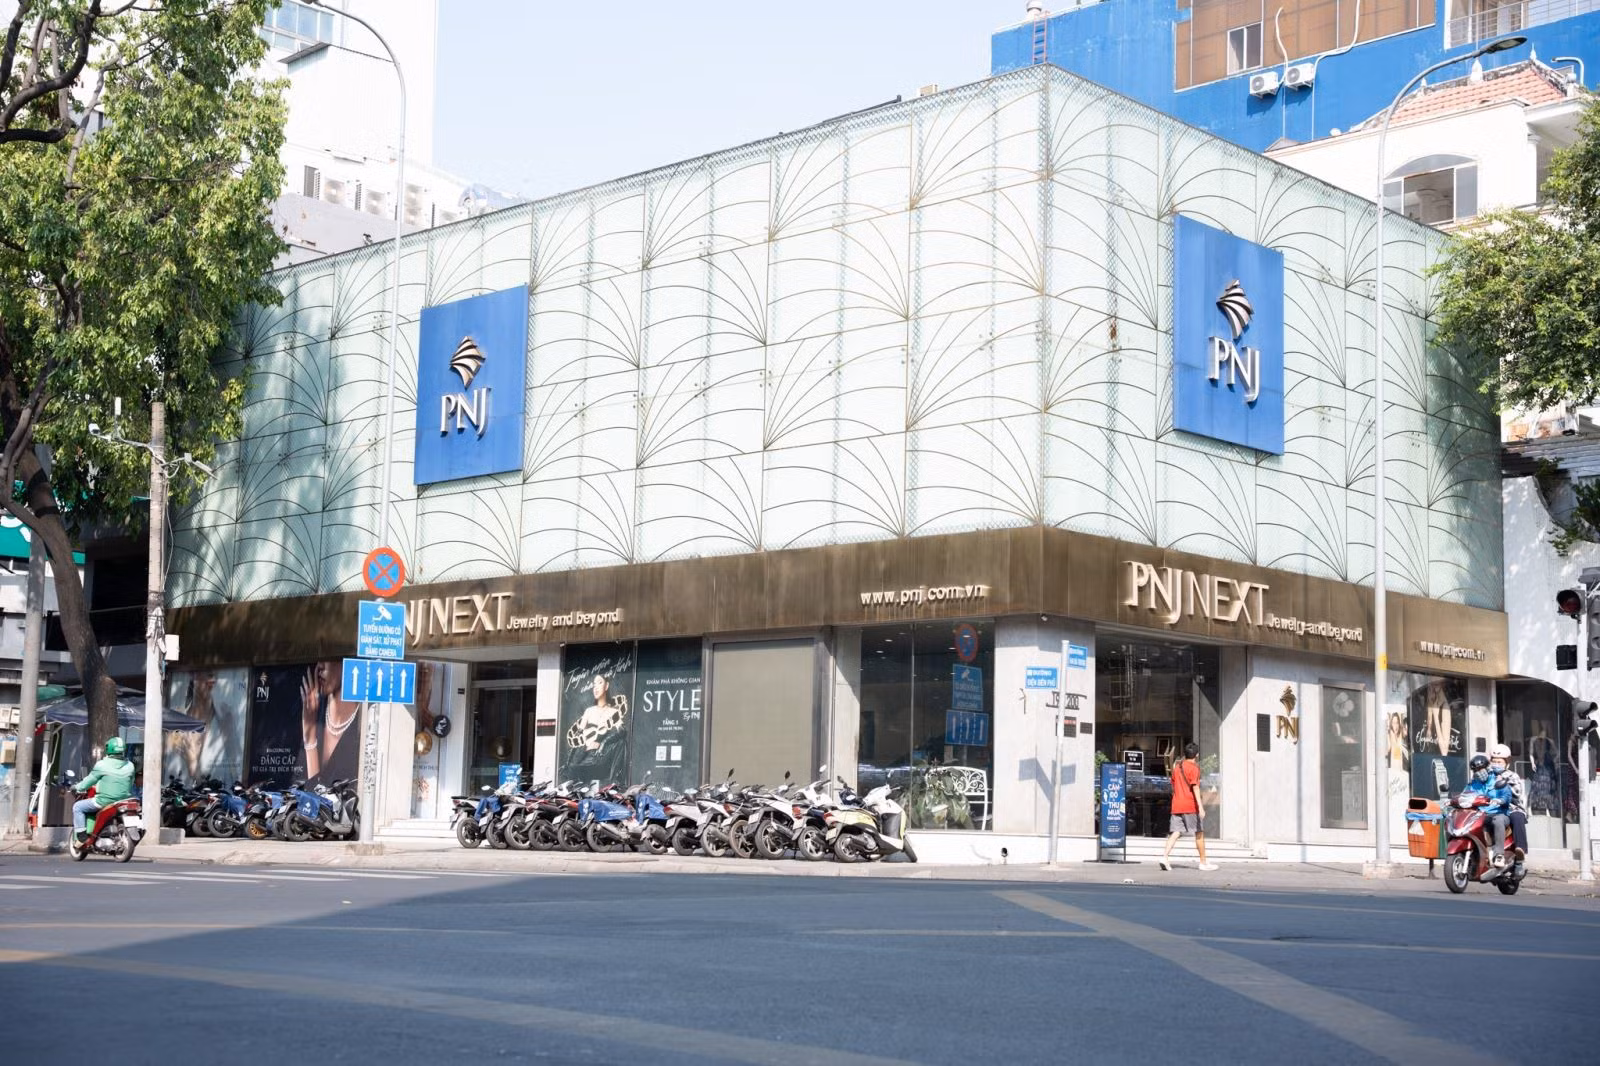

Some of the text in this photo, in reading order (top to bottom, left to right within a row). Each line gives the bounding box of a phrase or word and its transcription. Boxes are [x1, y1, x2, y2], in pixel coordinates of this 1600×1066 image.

[1208, 336, 1260, 403] PNJ
[440, 387, 490, 438] PNJ
[860, 584, 988, 605] www.pnj.com.vn
[1122, 560, 1269, 625] PNJ NEXT
[429, 592, 514, 635] NEXT
[506, 607, 621, 631] Jewelry and beyond
[1308, 621, 1326, 636] and
[1326, 622, 1362, 642] beyond
[257, 686, 270, 700] PNJ
[643, 689, 702, 712] STYLE
